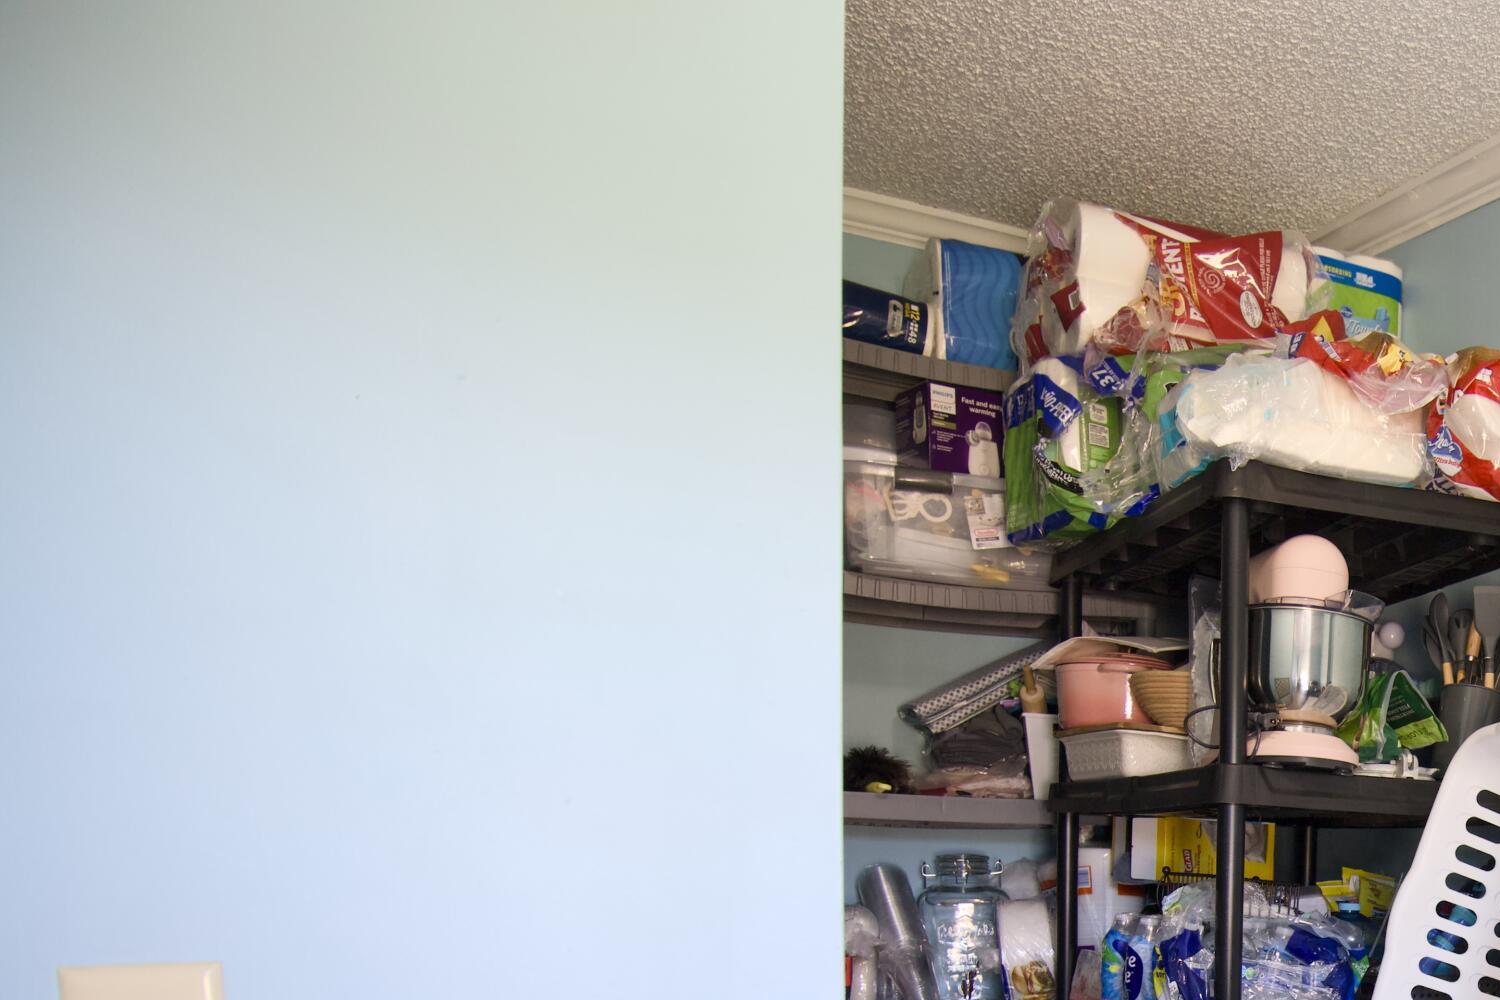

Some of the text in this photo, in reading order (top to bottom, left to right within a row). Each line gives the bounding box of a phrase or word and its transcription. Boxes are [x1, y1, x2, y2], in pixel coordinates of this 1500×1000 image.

[961, 396, 975, 406] Fast
[976, 399, 988, 408] and
[969, 406, 996, 418] warming
